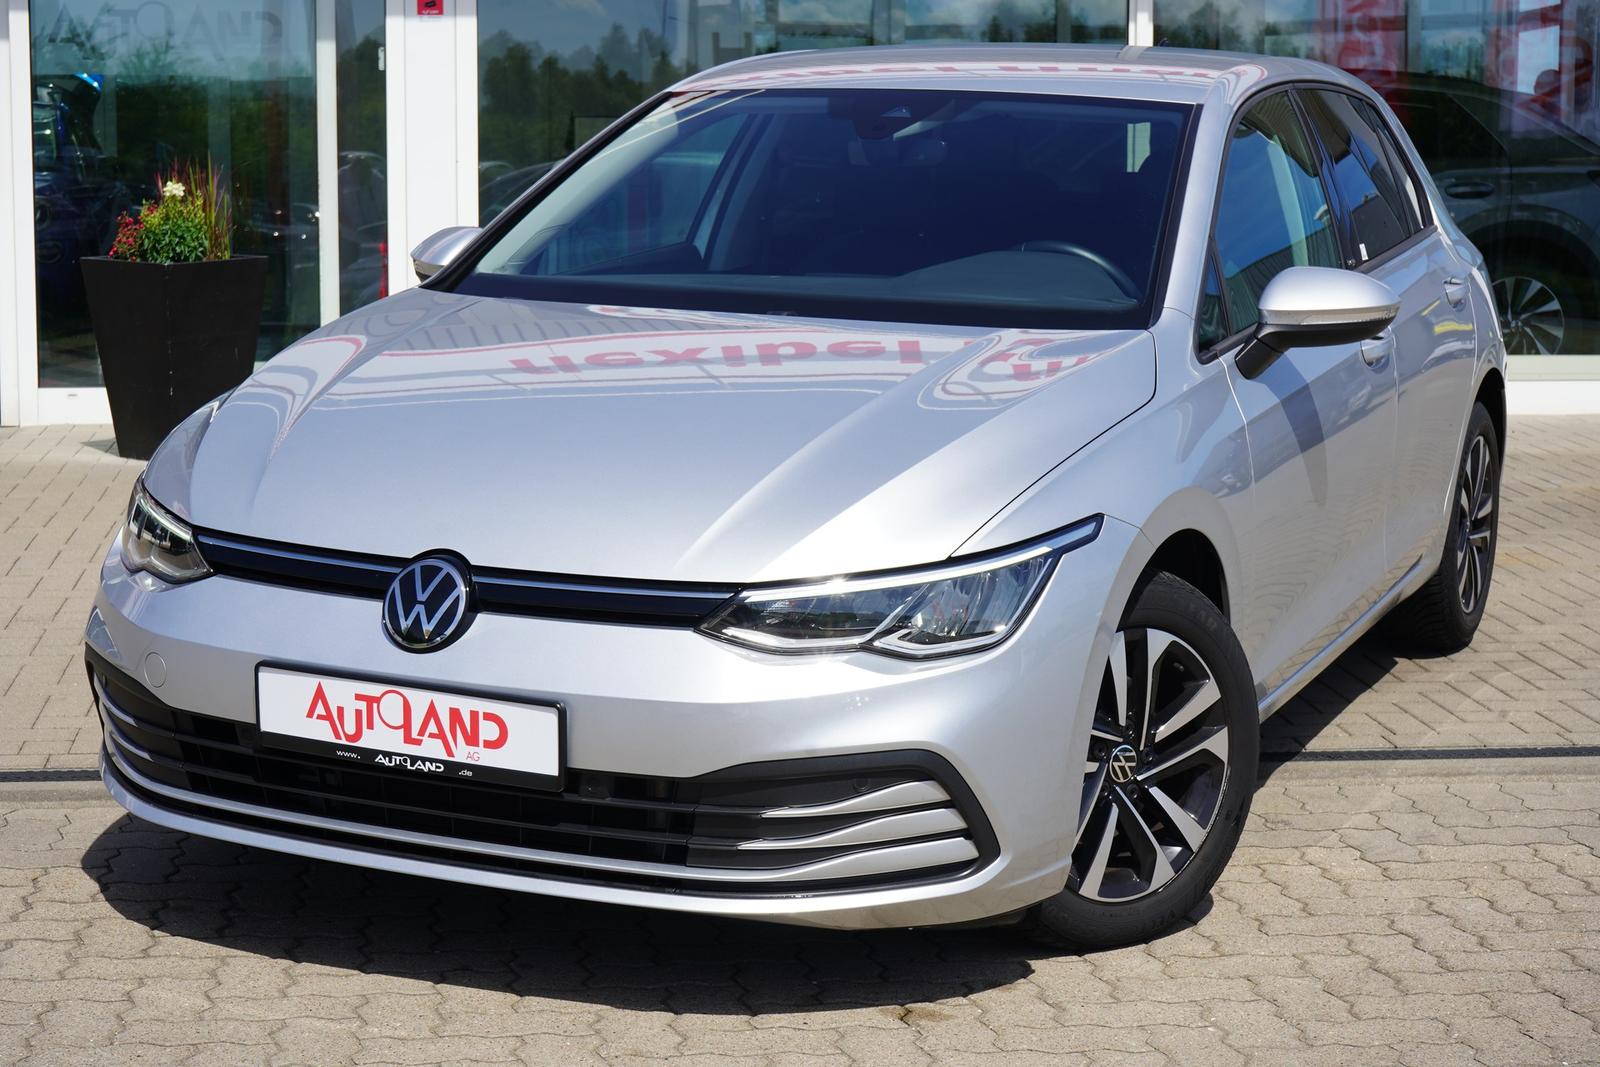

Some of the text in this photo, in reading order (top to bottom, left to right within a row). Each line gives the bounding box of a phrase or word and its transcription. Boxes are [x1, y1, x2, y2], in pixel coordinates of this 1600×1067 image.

[387, 560, 465, 646] VW
[336, 750, 361, 759] www.
[465, 751, 480, 762] AG
